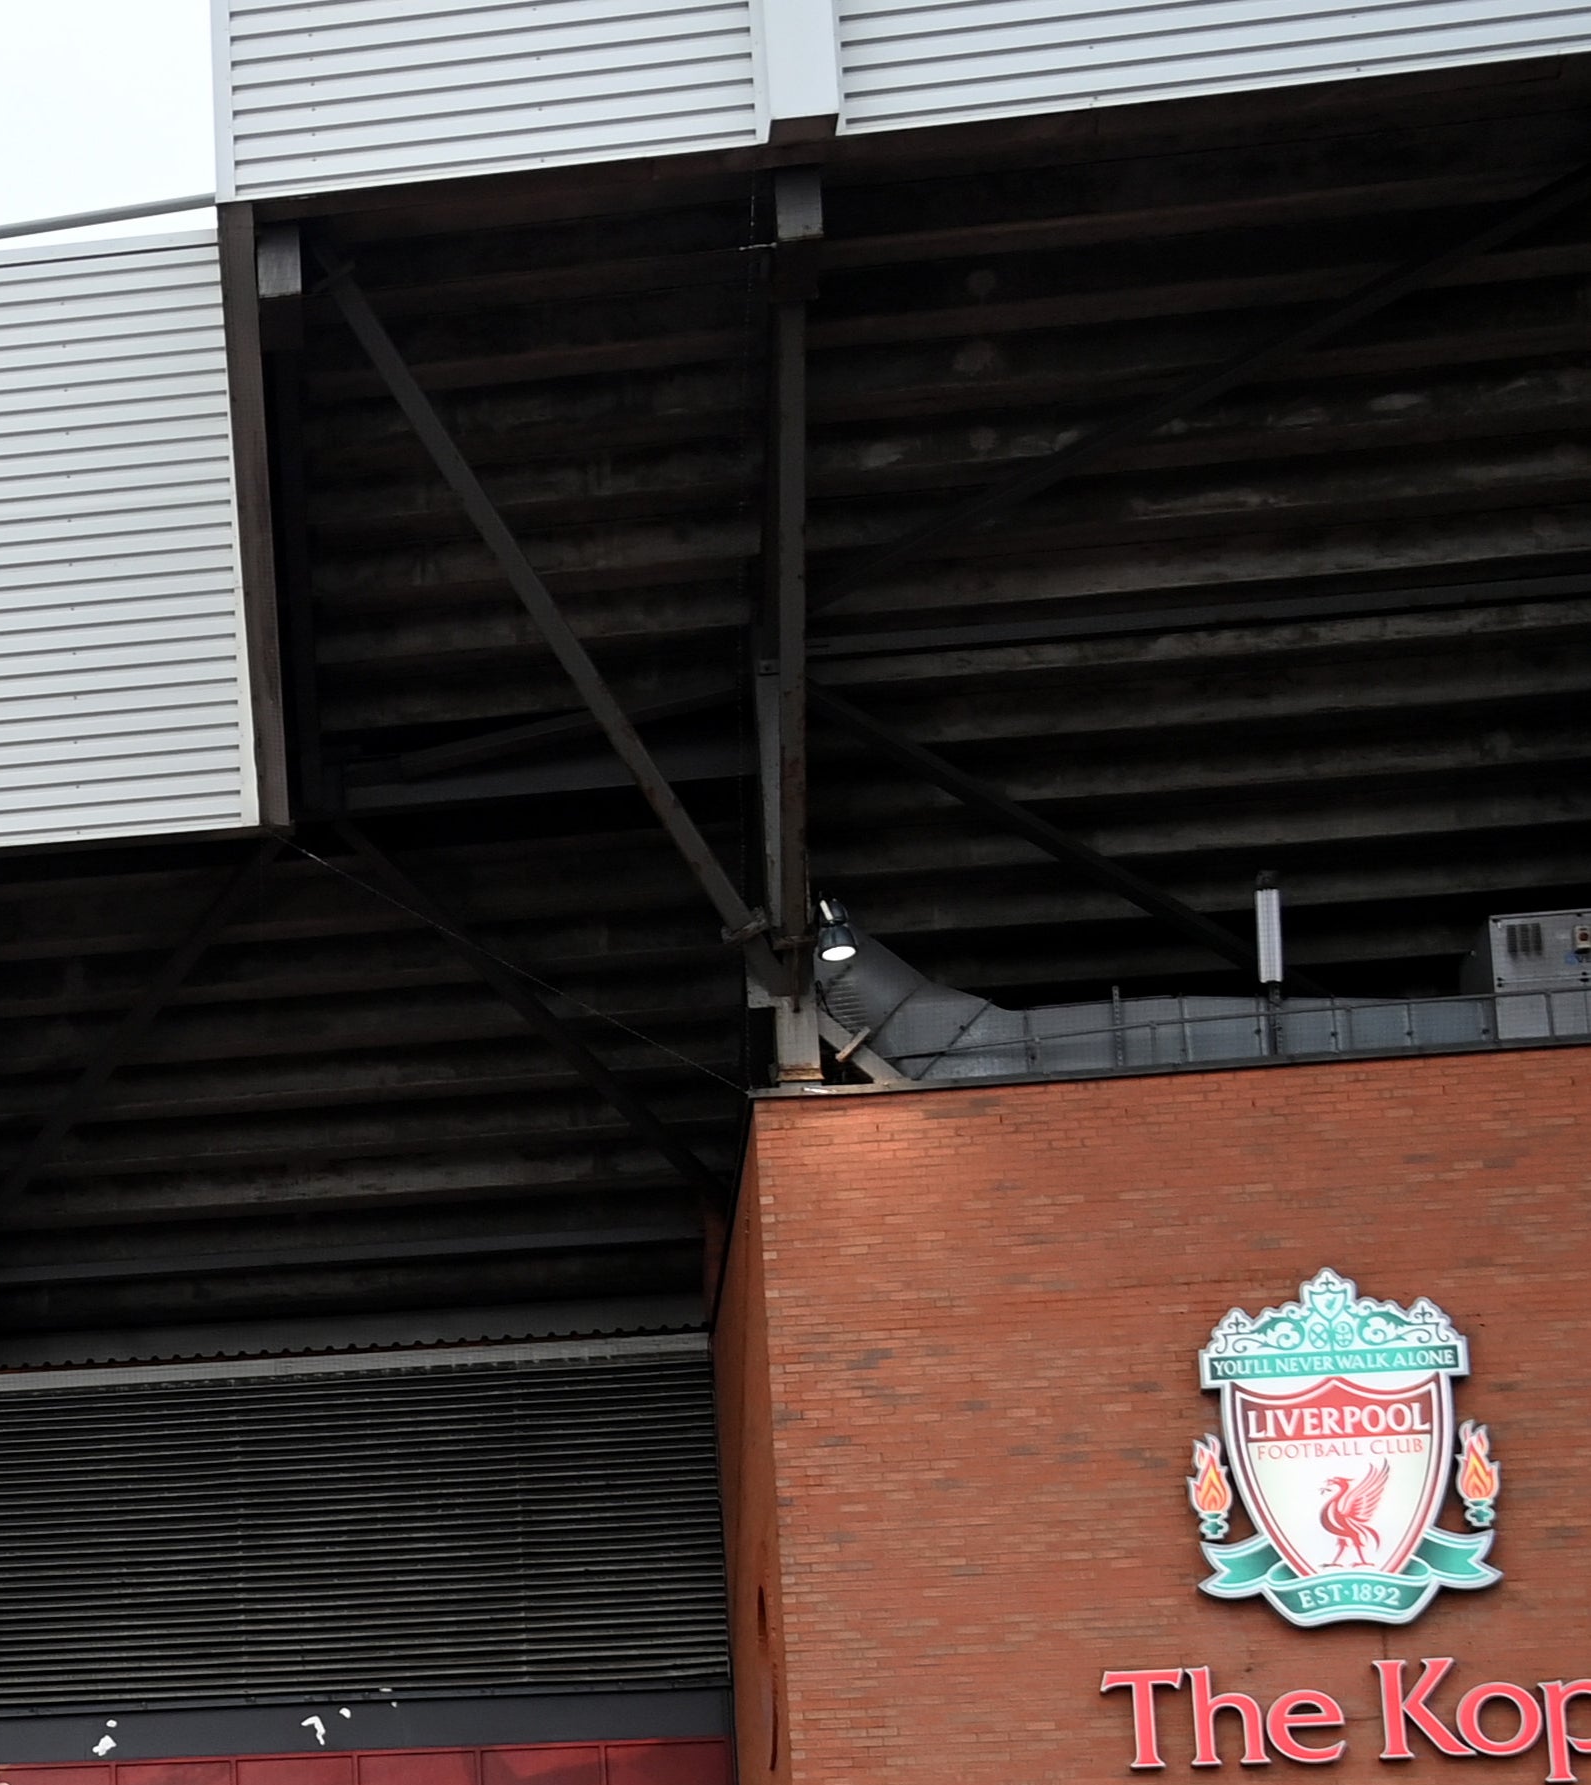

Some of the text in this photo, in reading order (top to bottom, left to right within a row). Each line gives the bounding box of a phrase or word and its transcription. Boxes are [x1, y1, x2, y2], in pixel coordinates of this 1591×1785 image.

[1212, 1349, 1455, 1377] YOU'LL NEVER WALK ALONE
[1247, 1402, 1431, 1438] LIVERPOOL
[1257, 1437, 1424, 1460] FOOTBALL CLUB
[1100, 1656, 1591, 1784] The Kop
